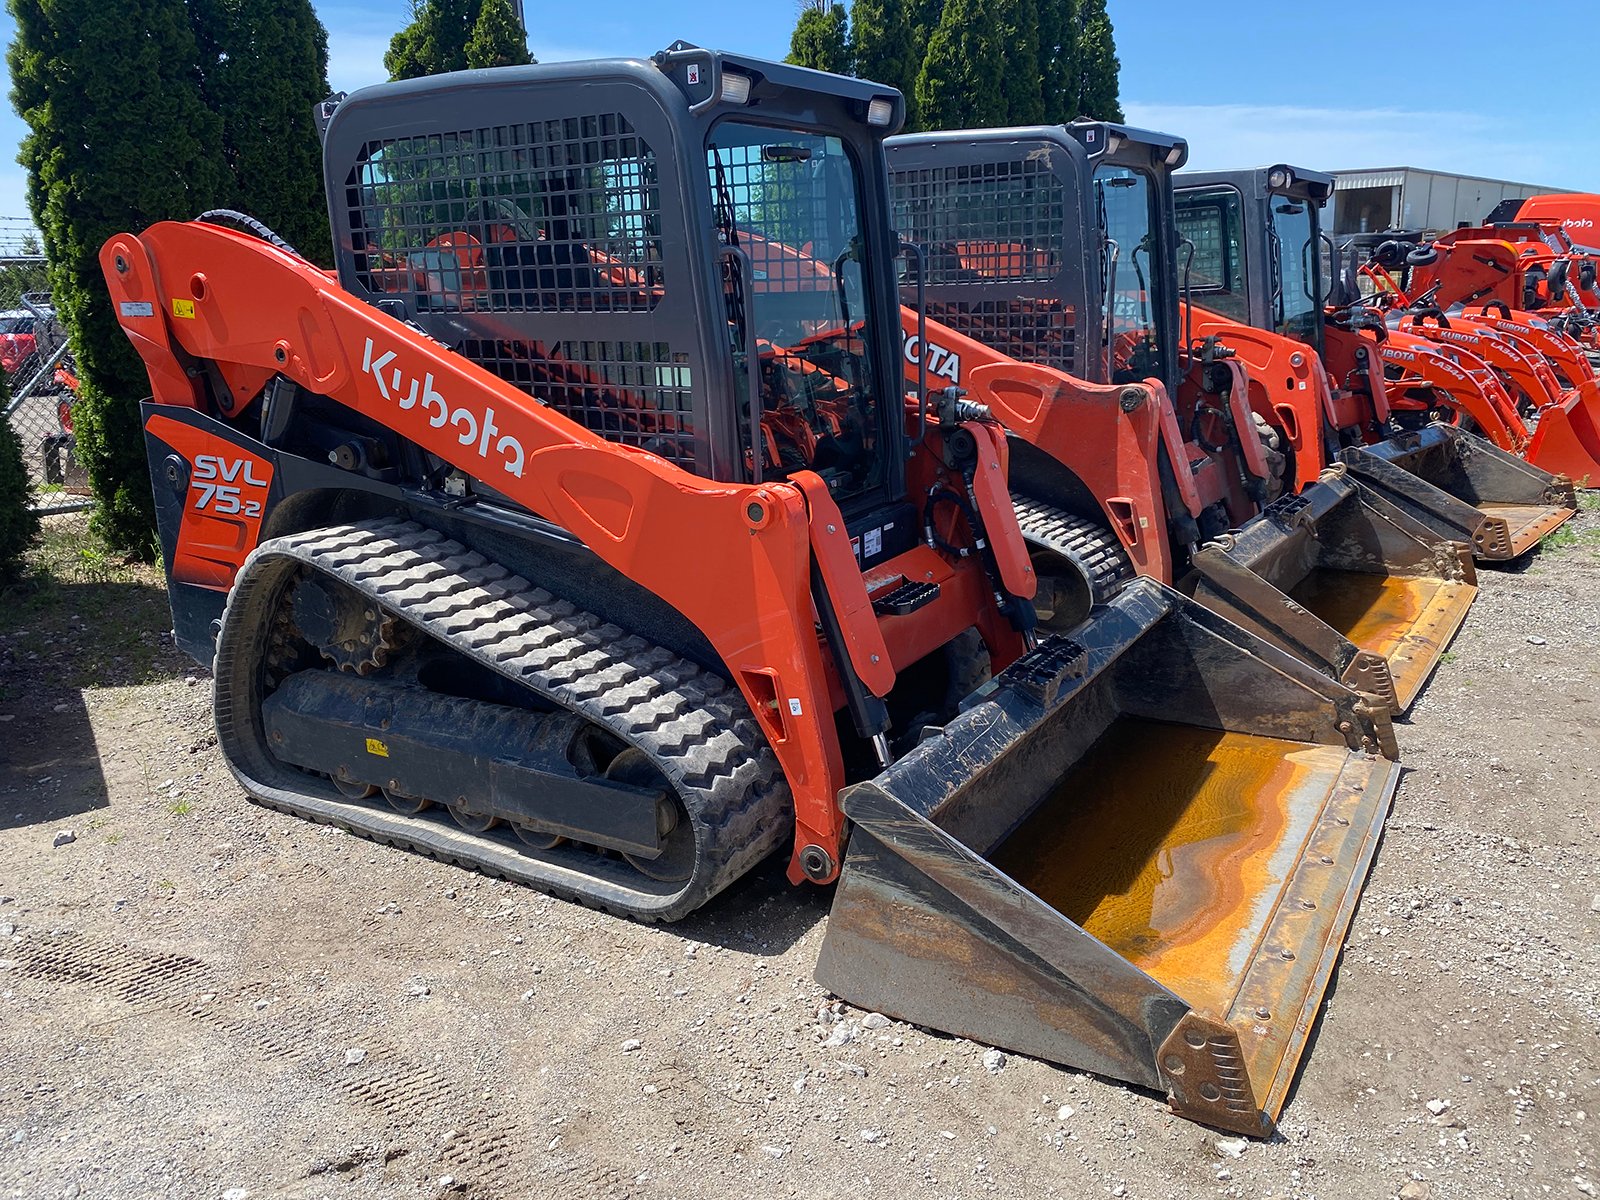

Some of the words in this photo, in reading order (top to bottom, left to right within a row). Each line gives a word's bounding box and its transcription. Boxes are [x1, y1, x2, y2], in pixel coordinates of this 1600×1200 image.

[1440, 330, 1479, 345] KUBOTA
[1496, 320, 1530, 335] KUBOTA
[1490, 341, 1521, 363] LA344
[1543, 333, 1569, 353] LA344
[902, 329, 959, 384] OTA
[1429, 357, 1466, 380] LA344
[362, 337, 525, 479] Kubota
[193, 454, 267, 487] SVL
[191, 481, 261, 518] 75-2
